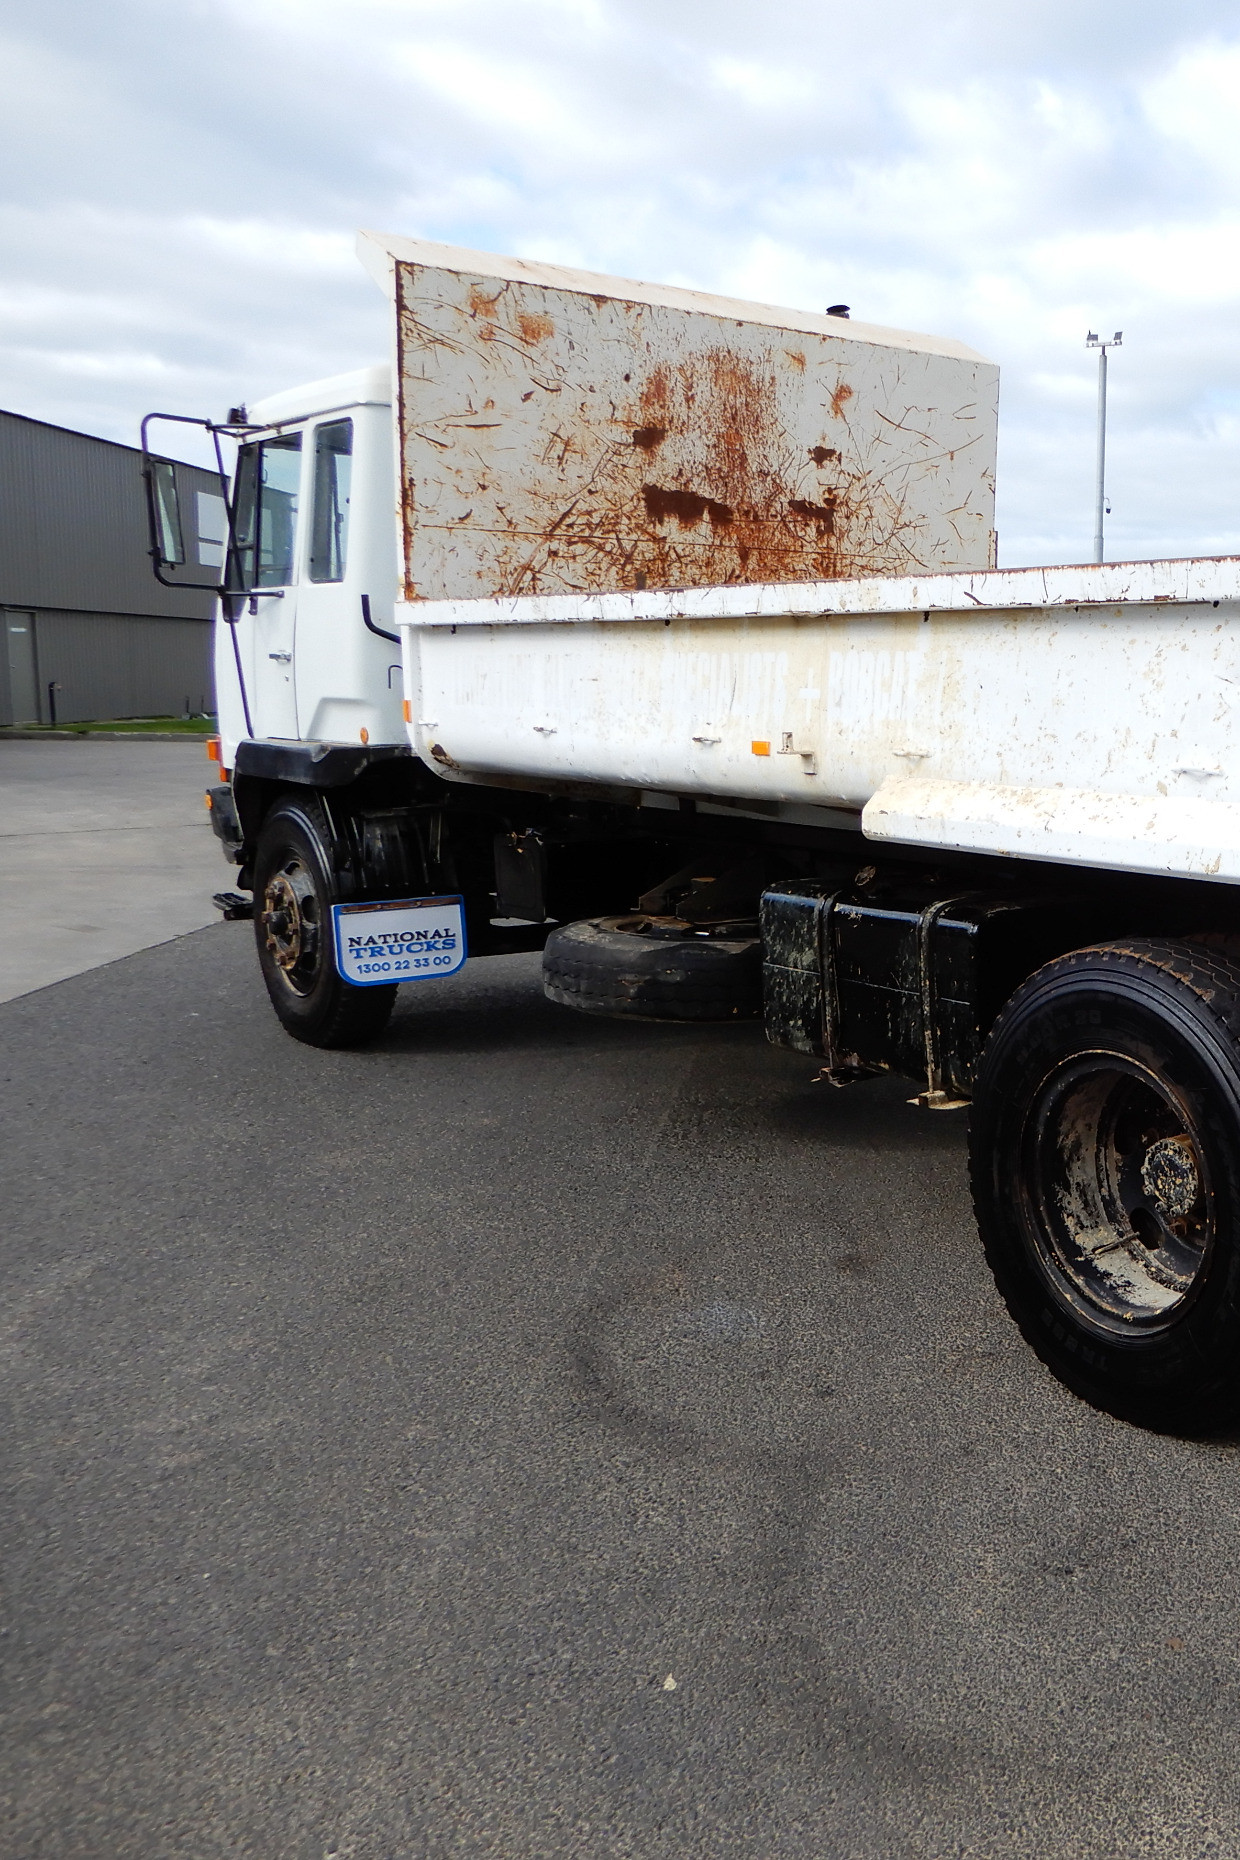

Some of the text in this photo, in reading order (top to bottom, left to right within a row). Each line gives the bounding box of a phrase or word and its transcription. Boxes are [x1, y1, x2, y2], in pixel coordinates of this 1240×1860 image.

[348, 928, 456, 947] NATIONAL
[348, 938, 457, 959] TRUCKS
[356, 955, 451, 974] 1300 22 33 00
